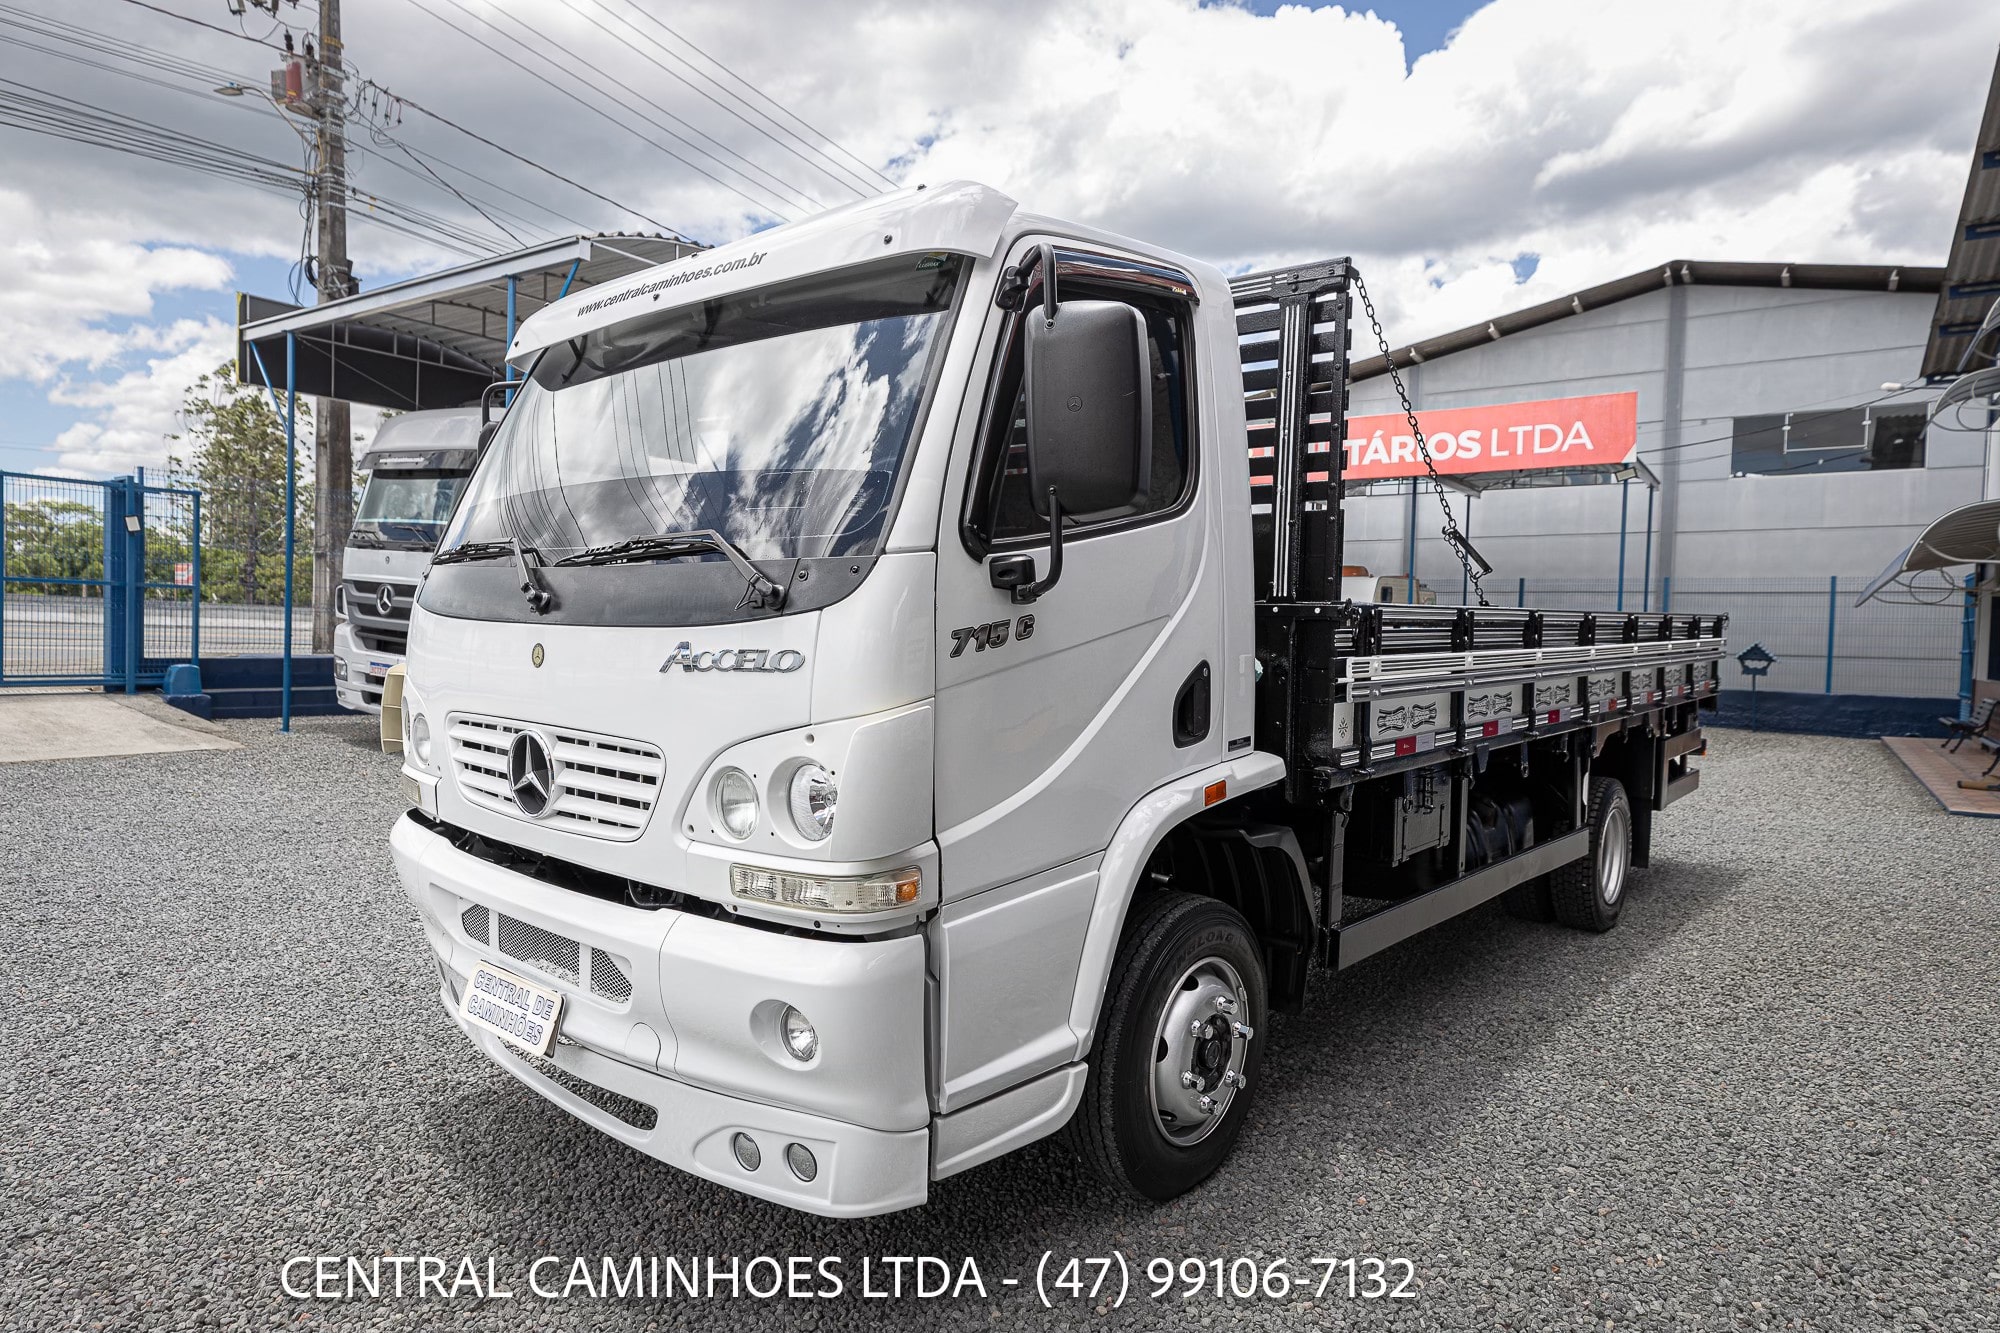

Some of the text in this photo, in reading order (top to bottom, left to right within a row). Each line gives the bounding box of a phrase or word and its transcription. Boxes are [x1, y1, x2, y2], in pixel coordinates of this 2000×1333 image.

[577, 251, 767, 317] www.centralcaminhoes.com.br
[1490, 420, 1595, 457] LTDA
[950, 613, 1036, 658] 715 C
[467, 994, 544, 1046] CAMINHÕES
[473, 969, 555, 1021] CENTRAL DE
